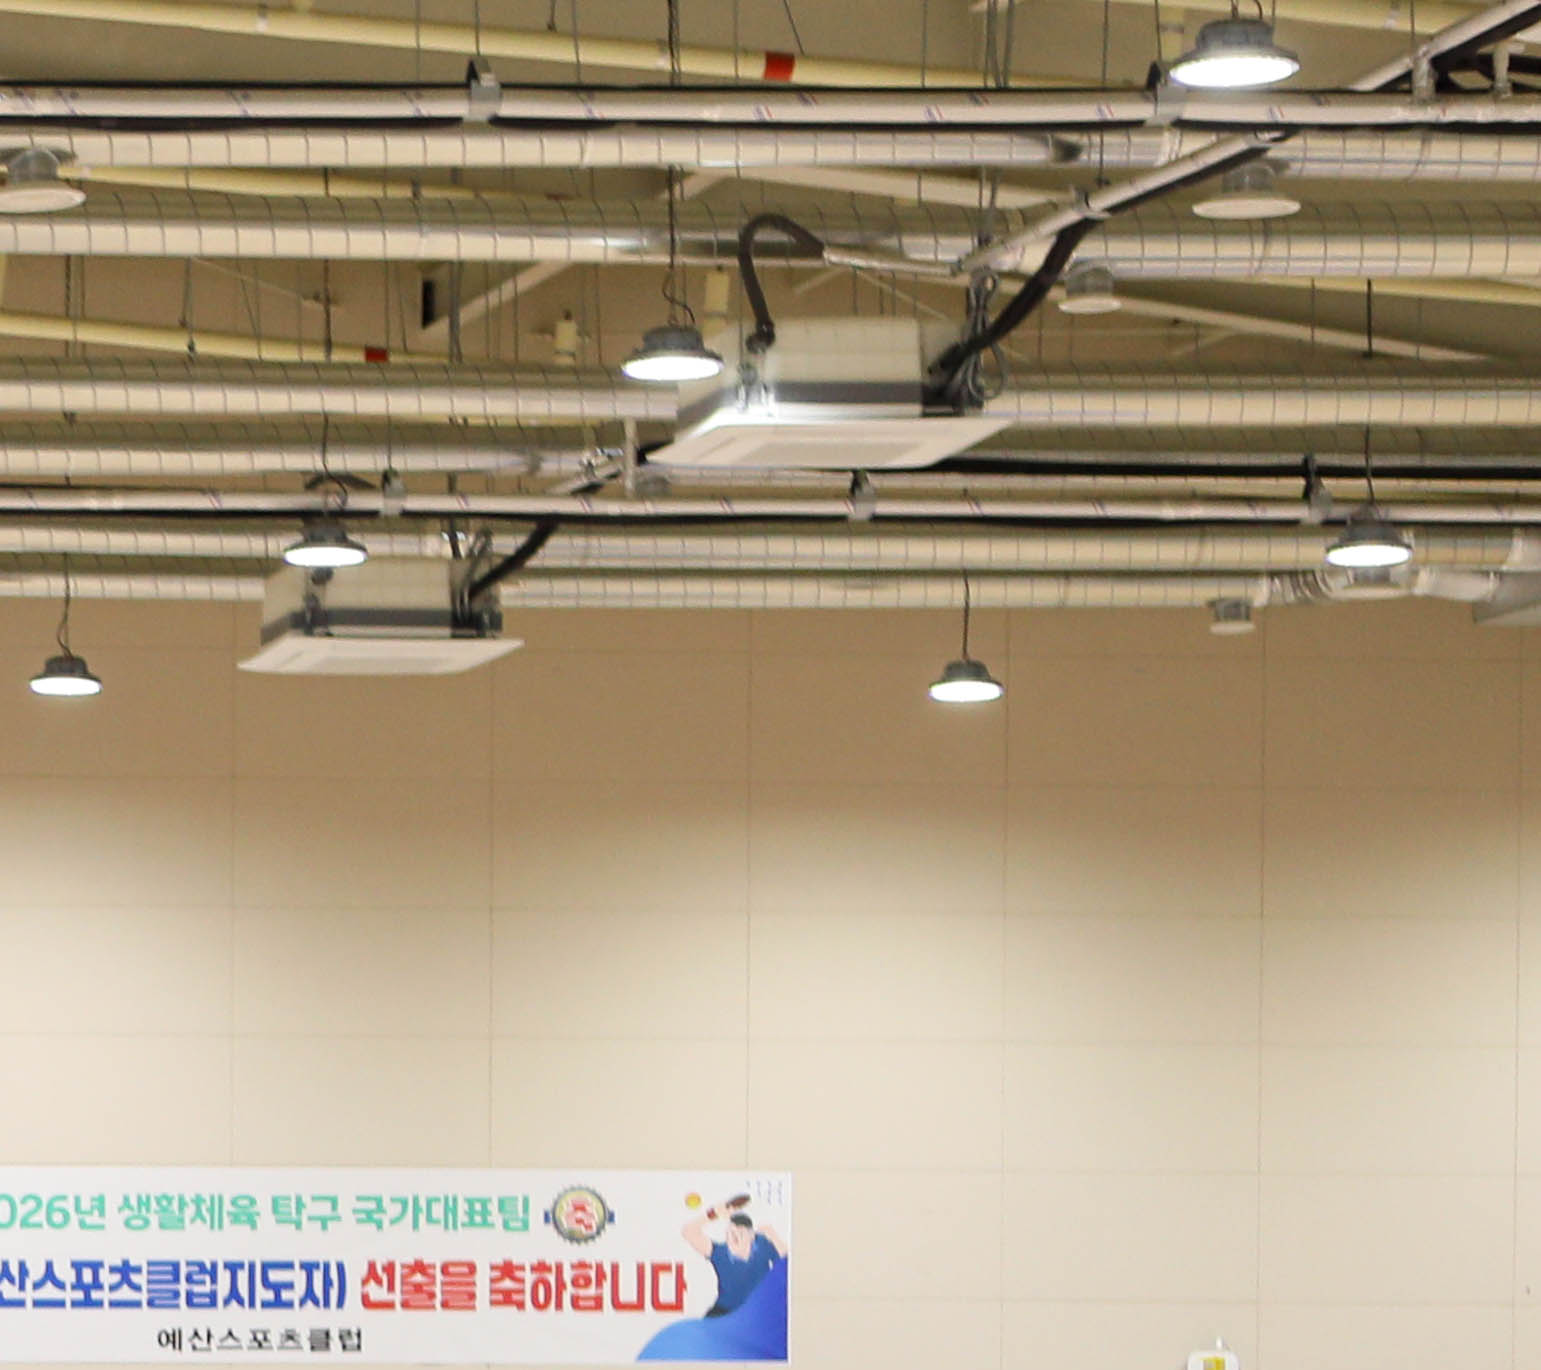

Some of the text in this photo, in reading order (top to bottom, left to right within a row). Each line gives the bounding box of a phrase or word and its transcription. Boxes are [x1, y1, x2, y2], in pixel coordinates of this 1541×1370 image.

[117, 1193, 261, 1231] 생활체육
[271, 1194, 343, 1232] 탁구
[352, 1194, 531, 1232] 국가대표팀
[360, 1260, 477, 1312] 선출을
[488, 1260, 689, 1313] 축하합니다
[157, 1327, 363, 1353] 예산스포츠클럽
